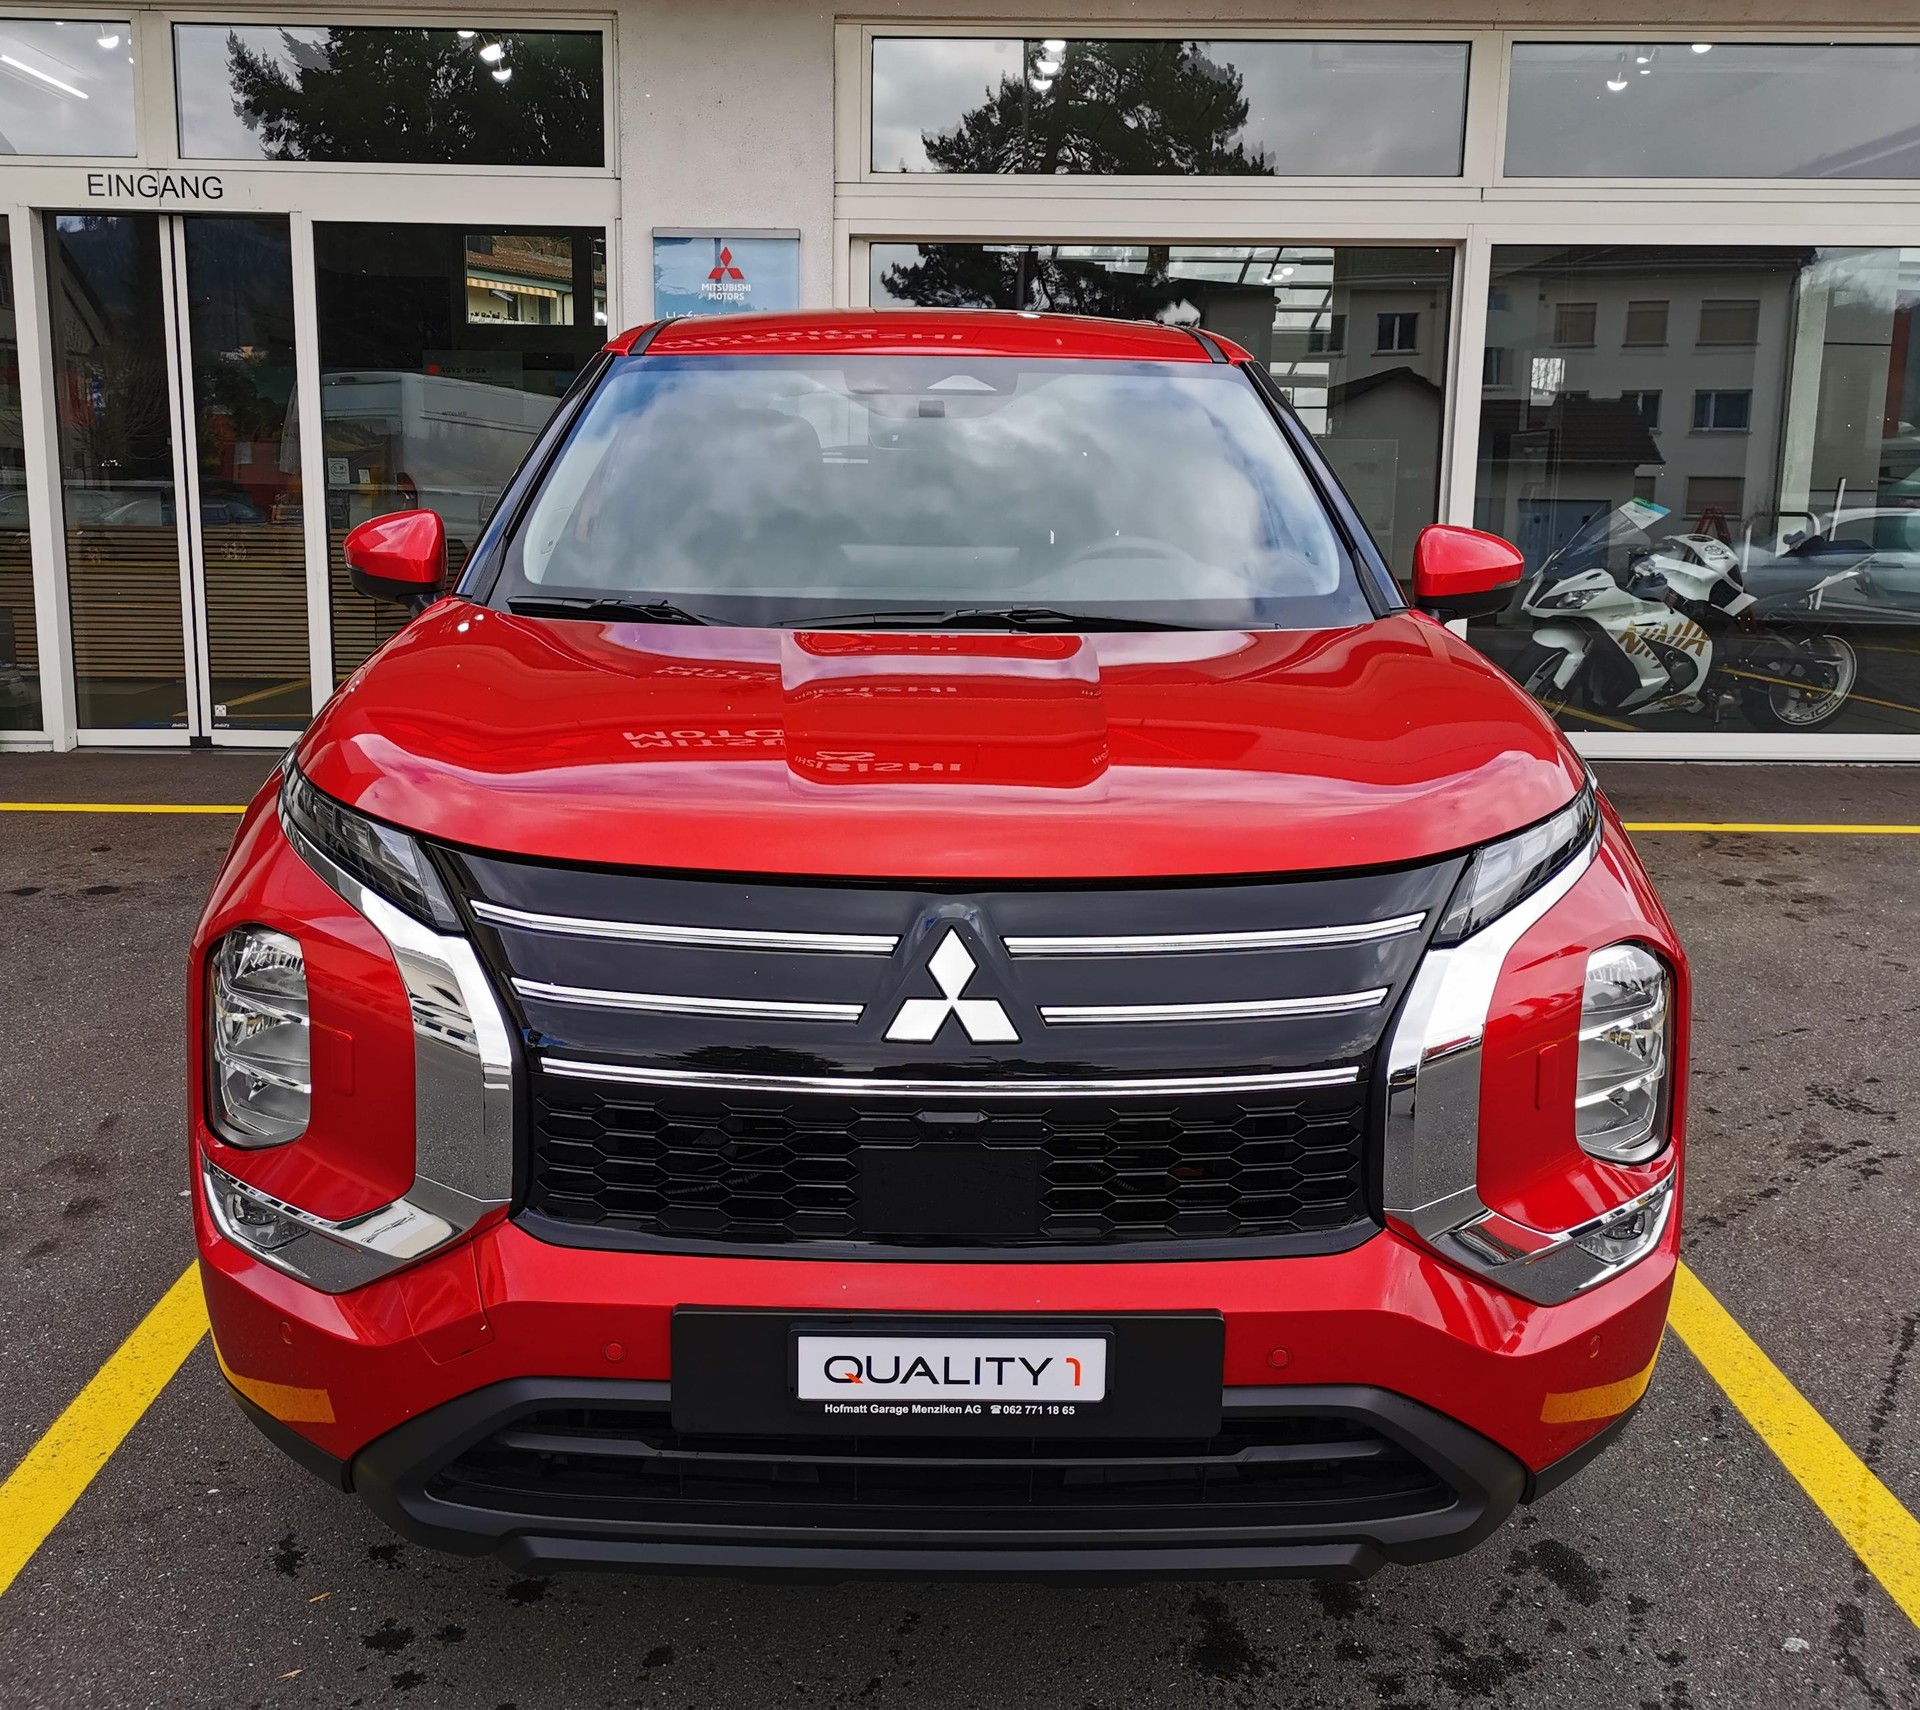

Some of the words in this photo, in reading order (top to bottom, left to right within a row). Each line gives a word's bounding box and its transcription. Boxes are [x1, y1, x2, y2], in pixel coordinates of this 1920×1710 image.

[87, 173, 224, 200] EINGANG
[701, 283, 752, 292] MITSUBISHI
[708, 292, 745, 301] MOTORS
[824, 1355, 1054, 1386] QUALITY
[1065, 1357, 1081, 1386] 1
[824, 1404, 868, 1414] Hofmatt
[870, 1405, 909, 1416] Garage
[911, 1404, 962, 1415] Menziken
[964, 1405, 982, 1415] AG
[1002, 1405, 1022, 1415] 062
[1024, 1405, 1044, 1415] 771
[1046, 1406, 1060, 1415] 18
[1061, 1406, 1076, 1415] 65
